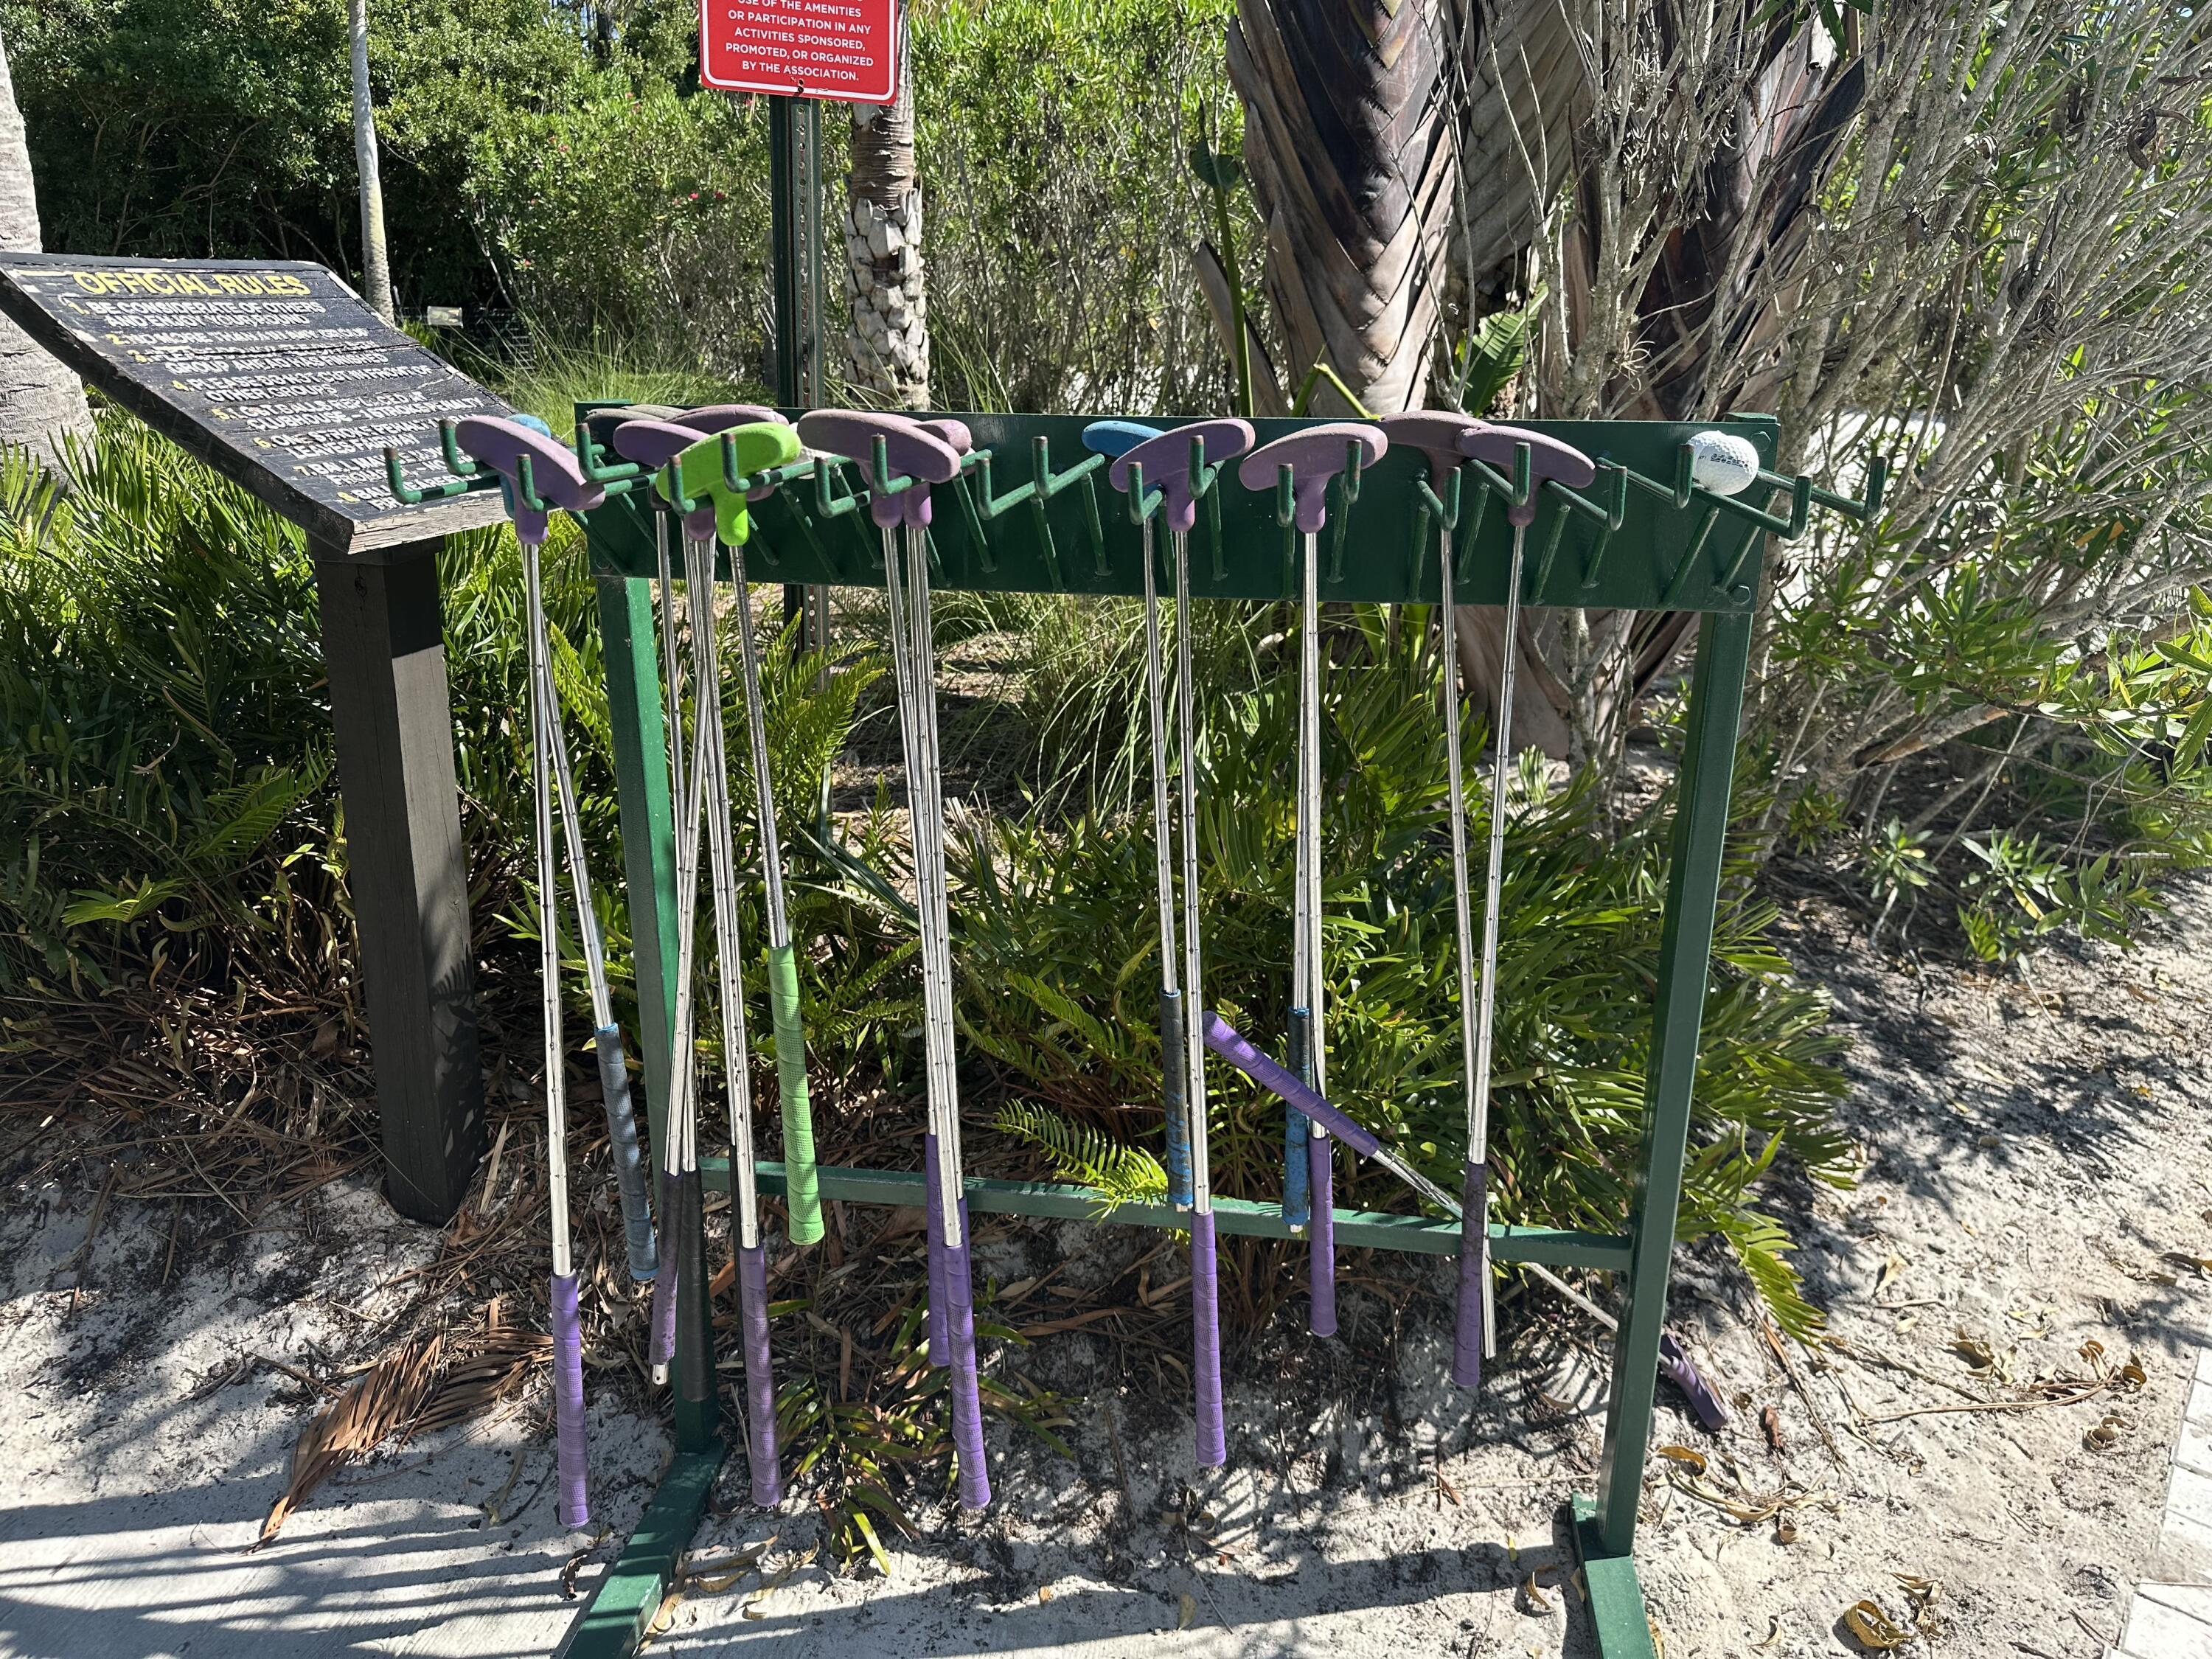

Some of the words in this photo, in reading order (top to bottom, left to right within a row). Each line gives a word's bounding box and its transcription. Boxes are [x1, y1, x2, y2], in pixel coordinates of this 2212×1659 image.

[780, 0, 801, 10] THE
[804, 2, 861, 17] AMENITIES
[728, 10, 745, 21] OR
[748, 12, 832, 30] PARTICIPATION
[835, 21, 846, 32] IN
[849, 24, 871, 35] ANY
[734, 27, 795, 43] ACTIVITIES
[798, 34, 866, 52] SPONSORED,
[726, 43, 790, 60] PROMOTED,
[792, 49, 808, 60] OR
[810, 52, 874, 67] ORGANIZED
[742, 60, 757, 71] BY
[759, 63, 780, 74] THE
[783, 65, 860, 81] ASSOCIATION.
[73, 271, 223, 295] OFFICIAL
[212, 274, 310, 295] RULES
[68, 302, 90, 315] 1.
[86, 302, 119, 314] BE
[116, 302, 243, 315] CONSIDERATE
[239, 302, 262, 314] OF
[262, 301, 326, 313] OTHERS
[105, 316, 148, 327] AND
[147, 315, 206, 327] ENJOY
[205, 314, 255, 327] YOUR
[254, 313, 310, 326] ROUND
[105, 333, 131, 345] 2.
[126, 334, 158, 345] NO
[154, 333, 214, 344] MORE
[207, 331, 259, 342] THAN
[318, 327, 368, 339] GROUP
[165, 361, 230, 375] GROUP
[232, 358, 291, 371] AHEAD
[285, 355, 325, 368] HAS
[319, 352, 389, 366] FINISHED
[171, 380, 195, 392] 4.
[187, 375, 262, 391] PLEASE
[317, 370, 352, 383] CUT
[348, 369, 371, 380] IN
[363, 366, 414, 379] FRONT
[411, 365, 432, 377] OF
[205, 388, 273, 402] OTHER
[267, 383, 338, 398] GROUPS
[212, 408, 234, 420] 5.
[274, 399, 333, 414] BALLS
[327, 393, 408, 410] REPLCED
[247, 411, 352, 431] CLUBHOUSE
[366, 403, 431, 420] STROKE
[422, 397, 485, 412] PENALTY
[254, 437, 277, 448] 6.
[271, 434, 313, 447] ONE
[307, 425, 378, 443] STROKE
[370, 417, 439, 435] PENALTY
[285, 439, 356, 459] LEAVES
[349, 433, 421, 451] FAIRWAY
[292, 465, 318, 476] 7.
